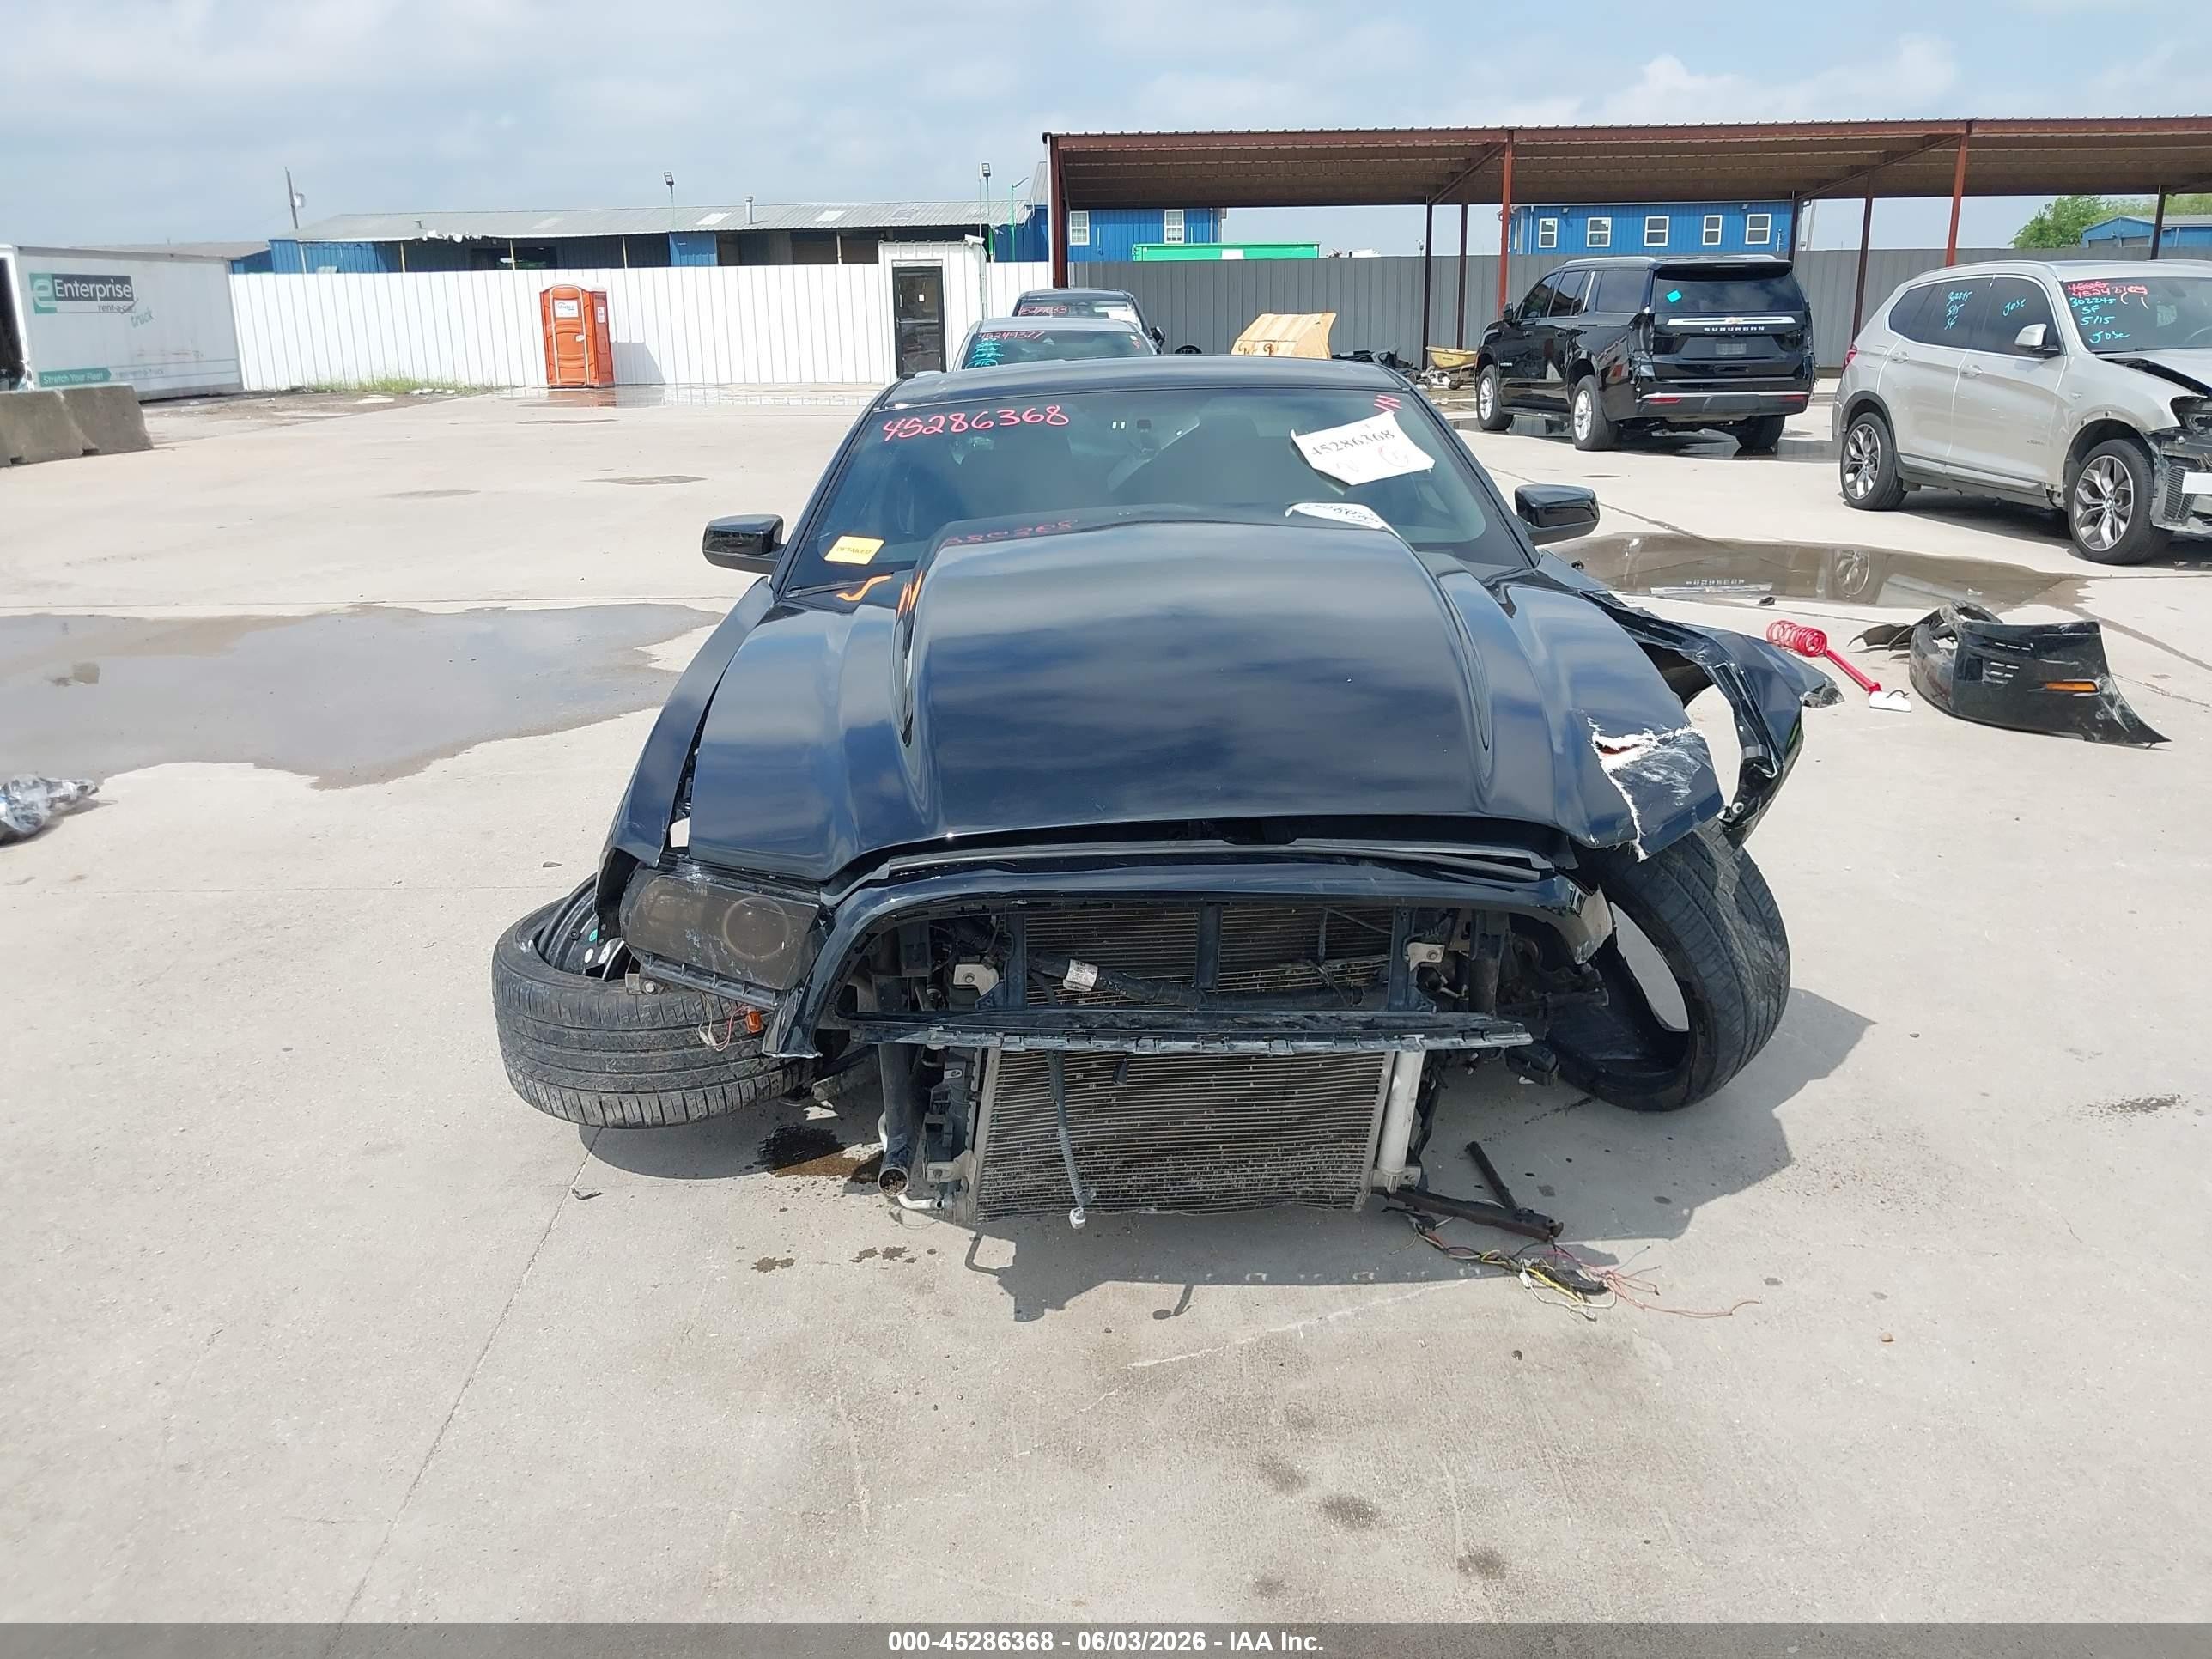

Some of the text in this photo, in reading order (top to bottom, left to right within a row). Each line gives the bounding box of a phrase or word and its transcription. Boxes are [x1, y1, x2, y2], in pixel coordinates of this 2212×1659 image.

[54, 278, 133, 302] Enterprise
[2069, 296, 2117, 308] 302245
[883, 404, 1070, 441] 45286368
[1311, 429, 1395, 455] 45286368
[836, 546, 872, 555] DETAILED
